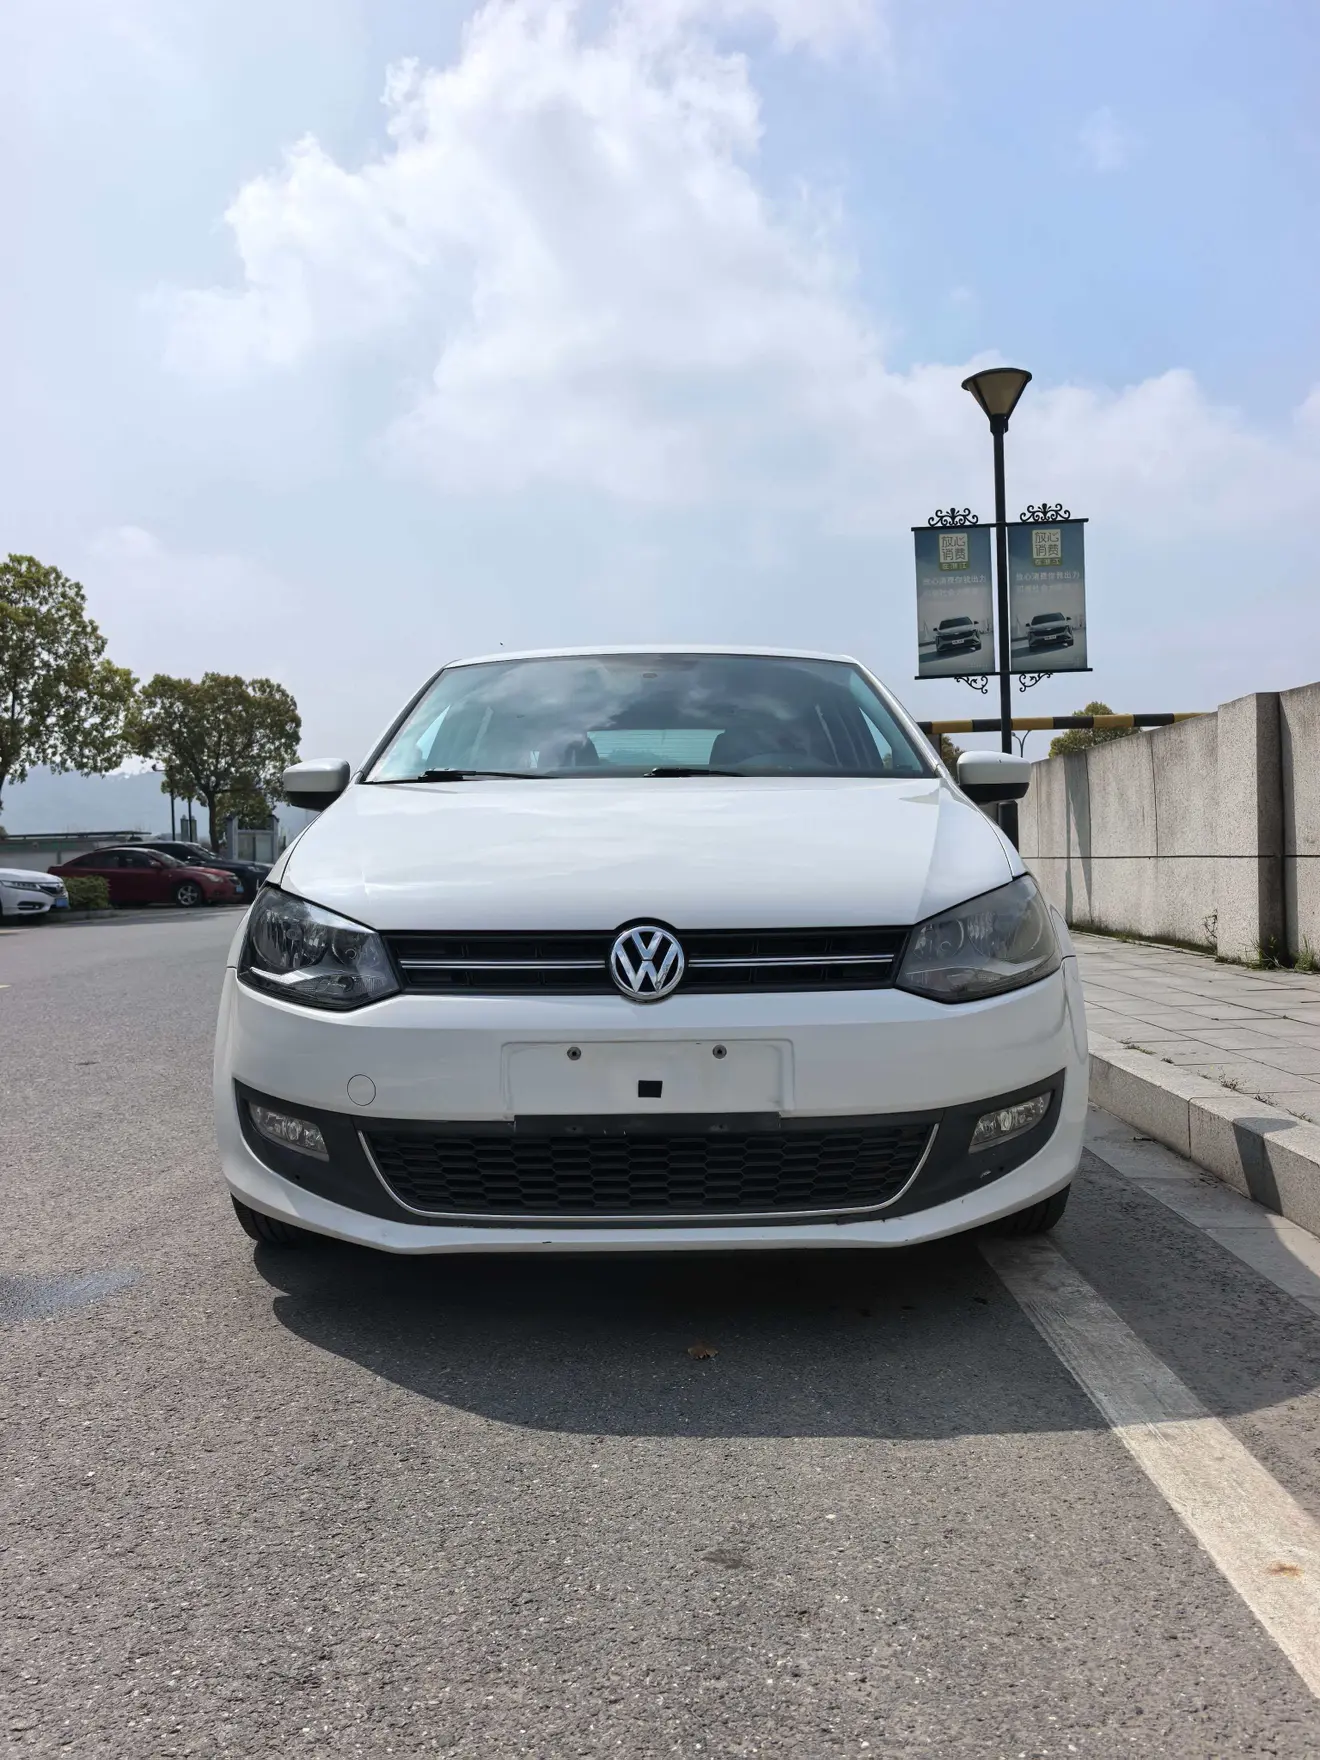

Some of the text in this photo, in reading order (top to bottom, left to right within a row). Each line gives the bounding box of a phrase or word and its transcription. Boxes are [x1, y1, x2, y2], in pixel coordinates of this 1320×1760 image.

[941, 535, 966, 548] 放心
[1034, 531, 1059, 544] 放心
[941, 548, 966, 561] 消费
[1034, 544, 1059, 557] 消费
